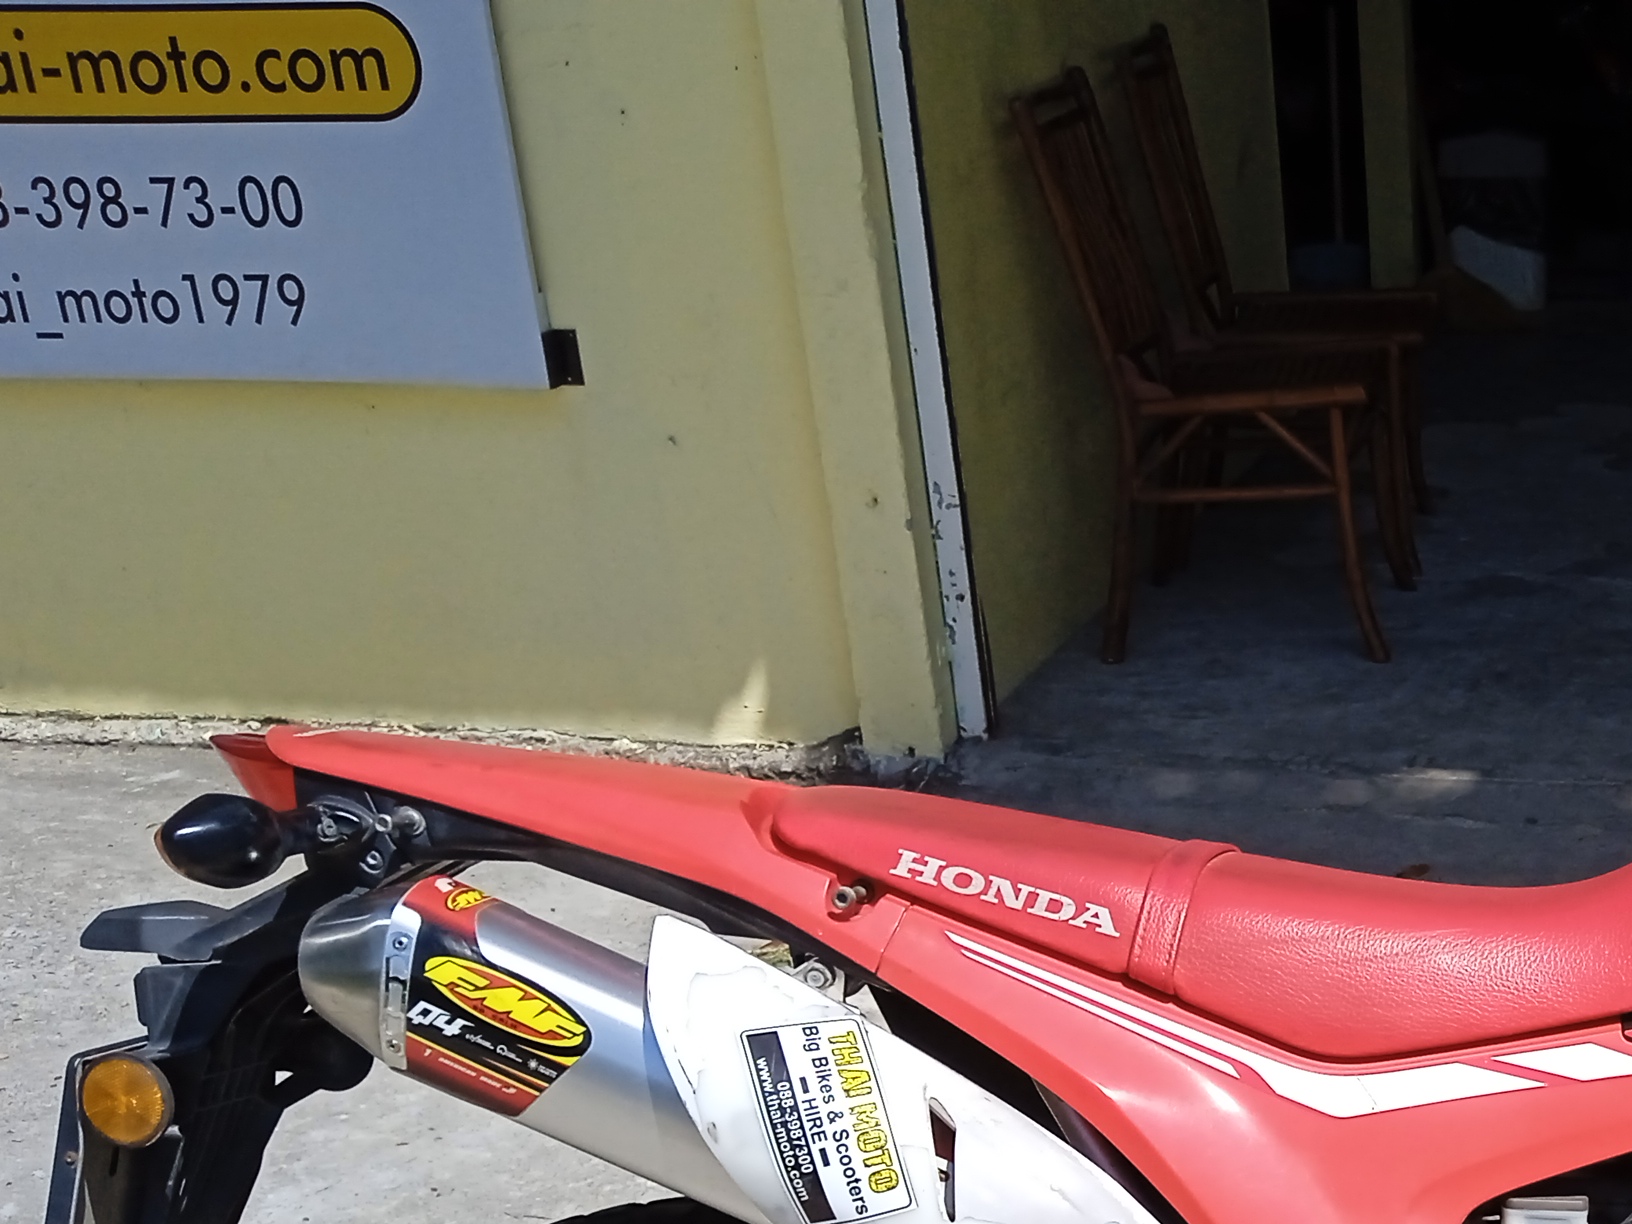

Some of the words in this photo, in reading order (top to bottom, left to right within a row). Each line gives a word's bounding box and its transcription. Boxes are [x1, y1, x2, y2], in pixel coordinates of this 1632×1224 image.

[888, 848, 1121, 938] HONDA
[406, 1000, 475, 1036] Q4
[424, 960, 587, 1040] FMF
[802, 1026, 820, 1052] Big
[827, 1030, 872, 1098] THAI
[811, 1056, 835, 1105] Bikes
[827, 1110, 844, 1125] &
[756, 1056, 809, 1201] www.thai-moto.com
[776, 1081, 814, 1174] 088-3987300
[801, 1098, 828, 1145] HIRE
[849, 1102, 899, 1194] MOTO
[832, 1128, 869, 1216] Scooters
